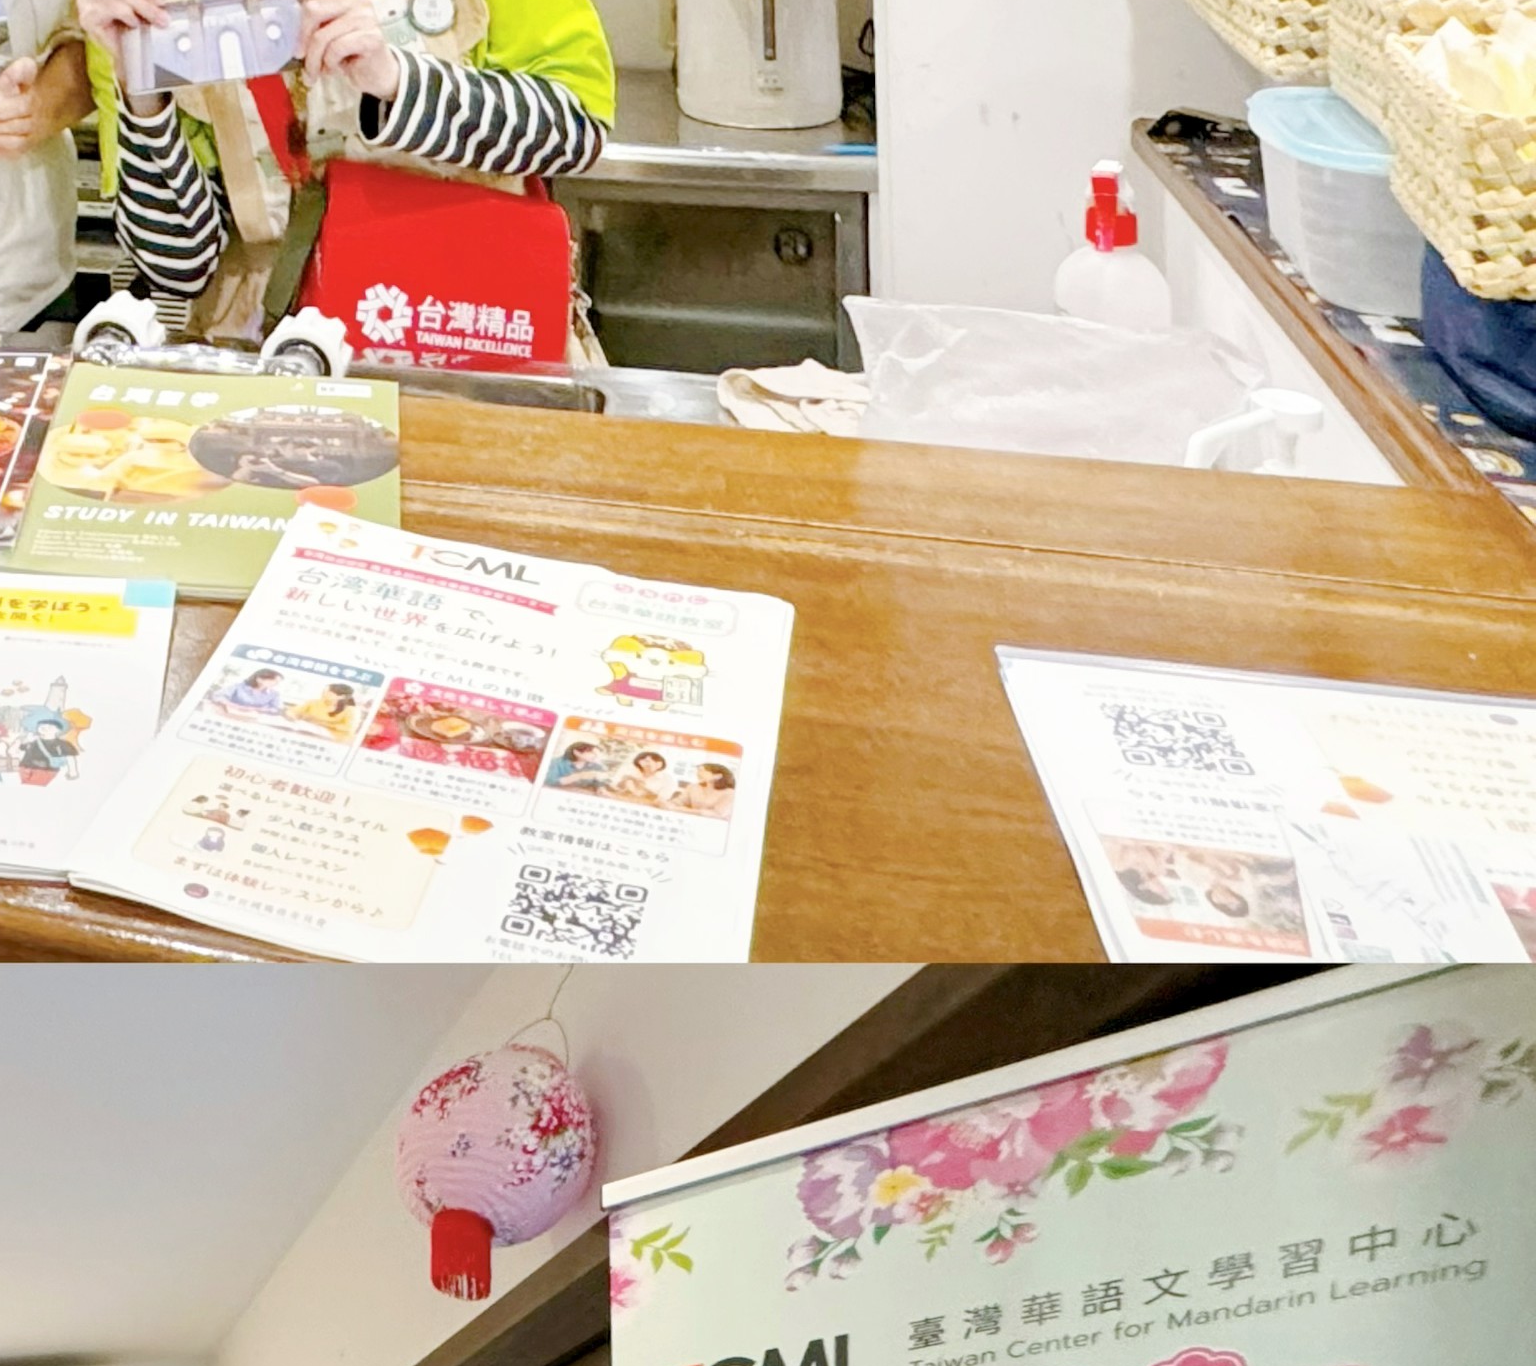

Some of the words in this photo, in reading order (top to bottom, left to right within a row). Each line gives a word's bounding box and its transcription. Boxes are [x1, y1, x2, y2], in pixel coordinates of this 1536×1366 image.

[416, 294, 535, 343] 台灣精品
[416, 331, 464, 351] TAIWAN
[464, 336, 533, 359] EXCELLENCE
[88, 383, 221, 407] 台湾留学
[42, 504, 135, 522] STUDY
[144, 511, 178, 526] IN
[187, 512, 295, 533] TAIWAN
[407, 540, 541, 586] TCML
[907, 1211, 1481, 1353] 臺灣華語文學習中心
[1006, 1330, 1102, 1361] Center
[1114, 1317, 1156, 1341] for
[1166, 1286, 1316, 1331] Mandarin
[1328, 1258, 1489, 1302] Learning
